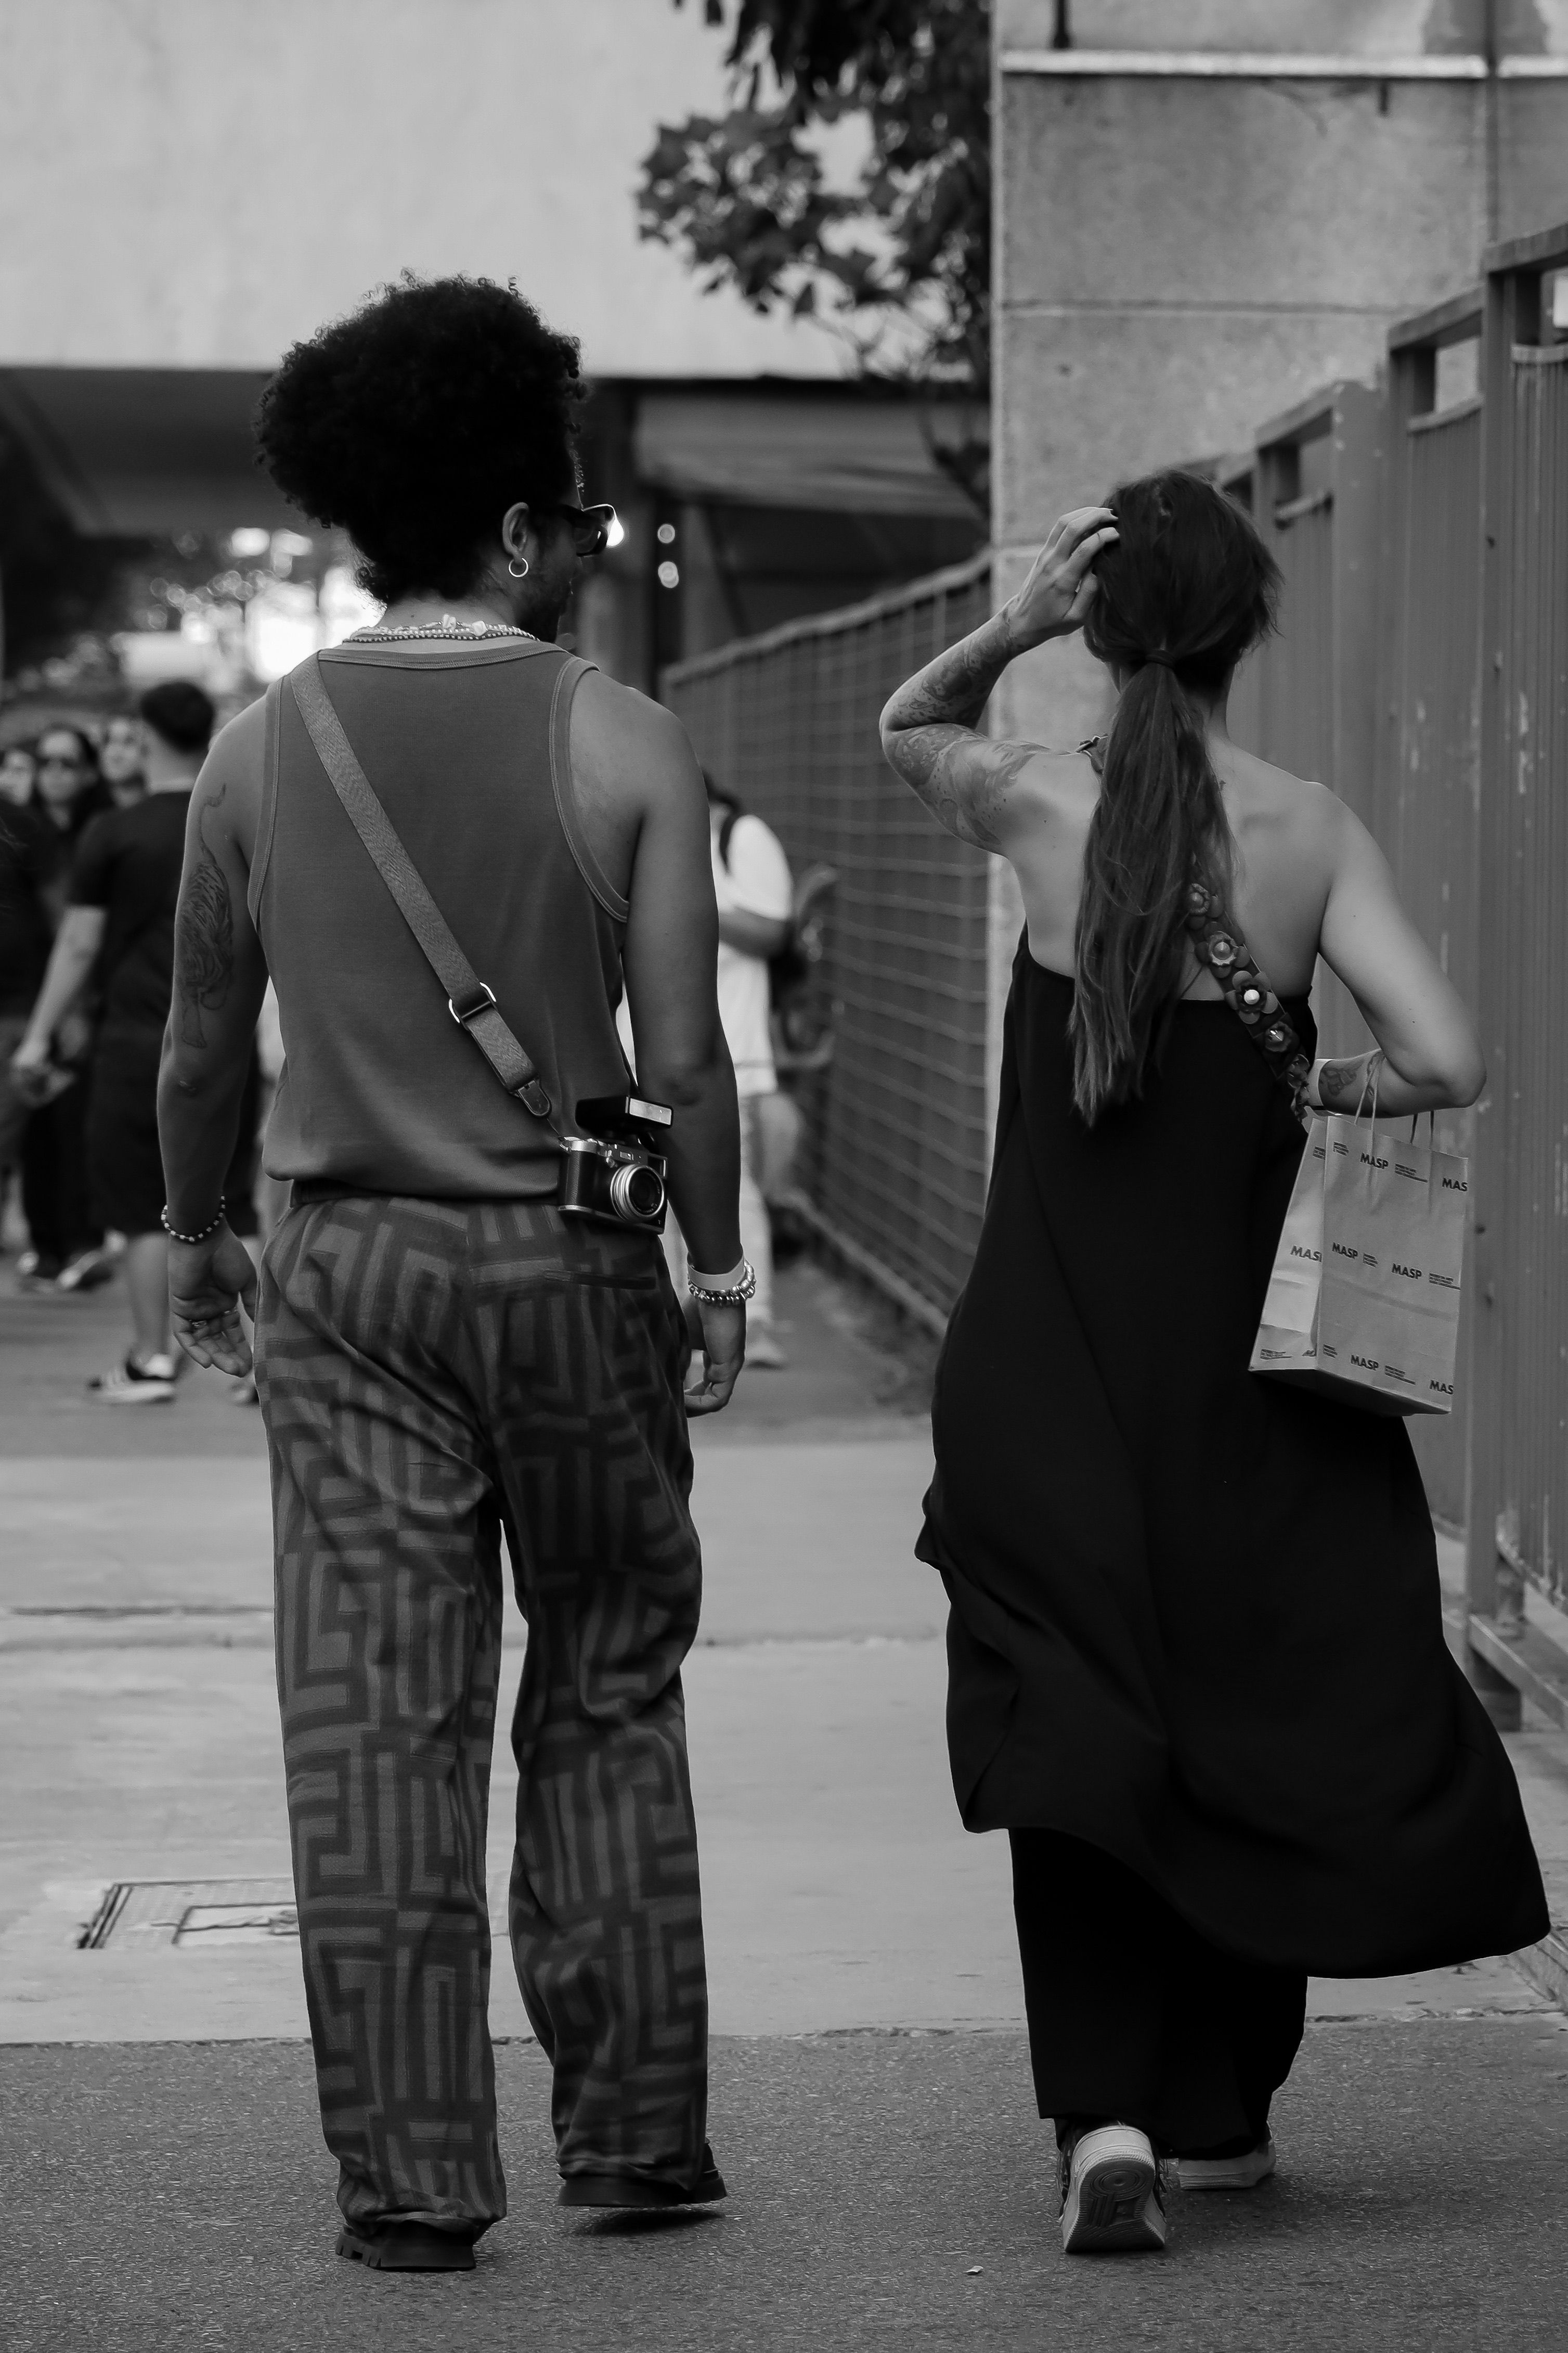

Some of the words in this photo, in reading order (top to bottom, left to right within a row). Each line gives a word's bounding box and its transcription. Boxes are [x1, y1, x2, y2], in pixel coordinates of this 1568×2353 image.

[1360, 1152, 1389, 1169] MASP
[1290, 1245, 1323, 1262] MAS
[1332, 1242, 1358, 1259] MASP
[1392, 1263, 1422, 1280] MASP
[1351, 1354, 1379, 1371] MASP
